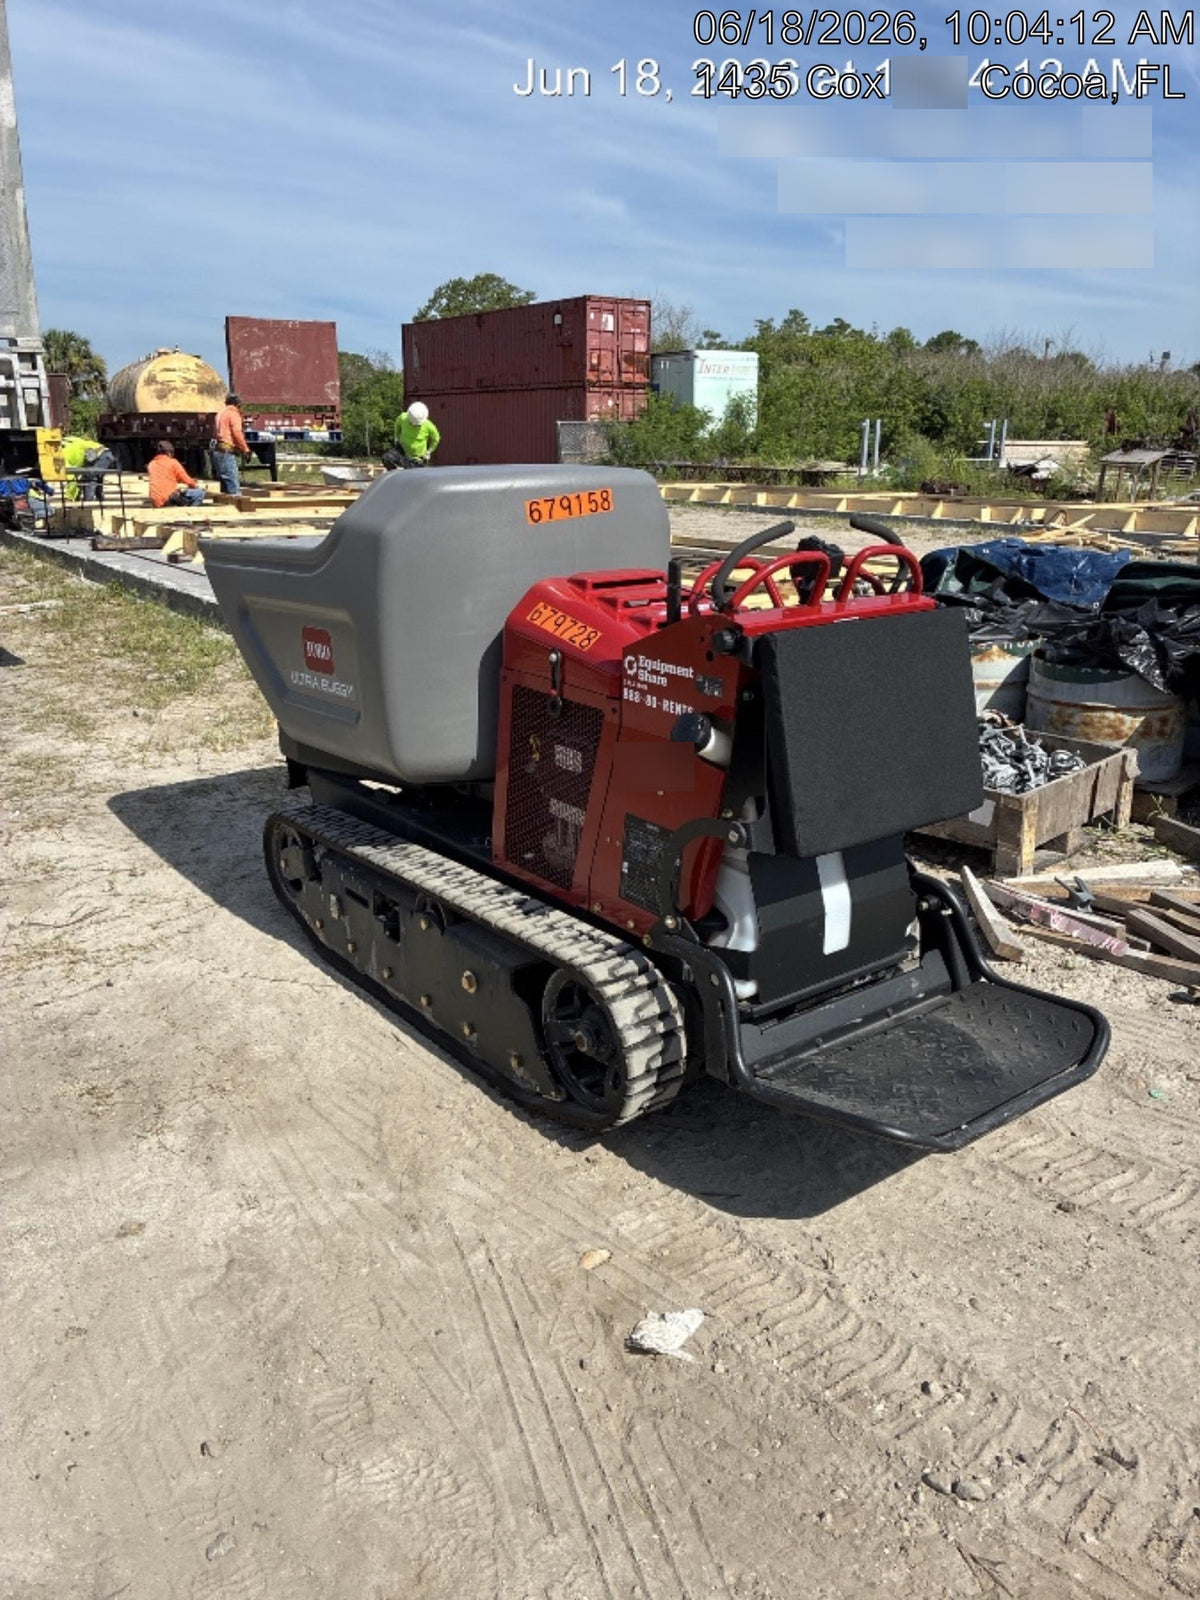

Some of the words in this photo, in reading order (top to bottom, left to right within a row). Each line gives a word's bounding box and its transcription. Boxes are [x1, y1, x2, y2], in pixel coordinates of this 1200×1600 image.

[529, 490, 610, 523] 679158
[530, 604, 598, 648] 679728
[638, 655, 694, 678] Equipment
[638, 669, 668, 687] Share
